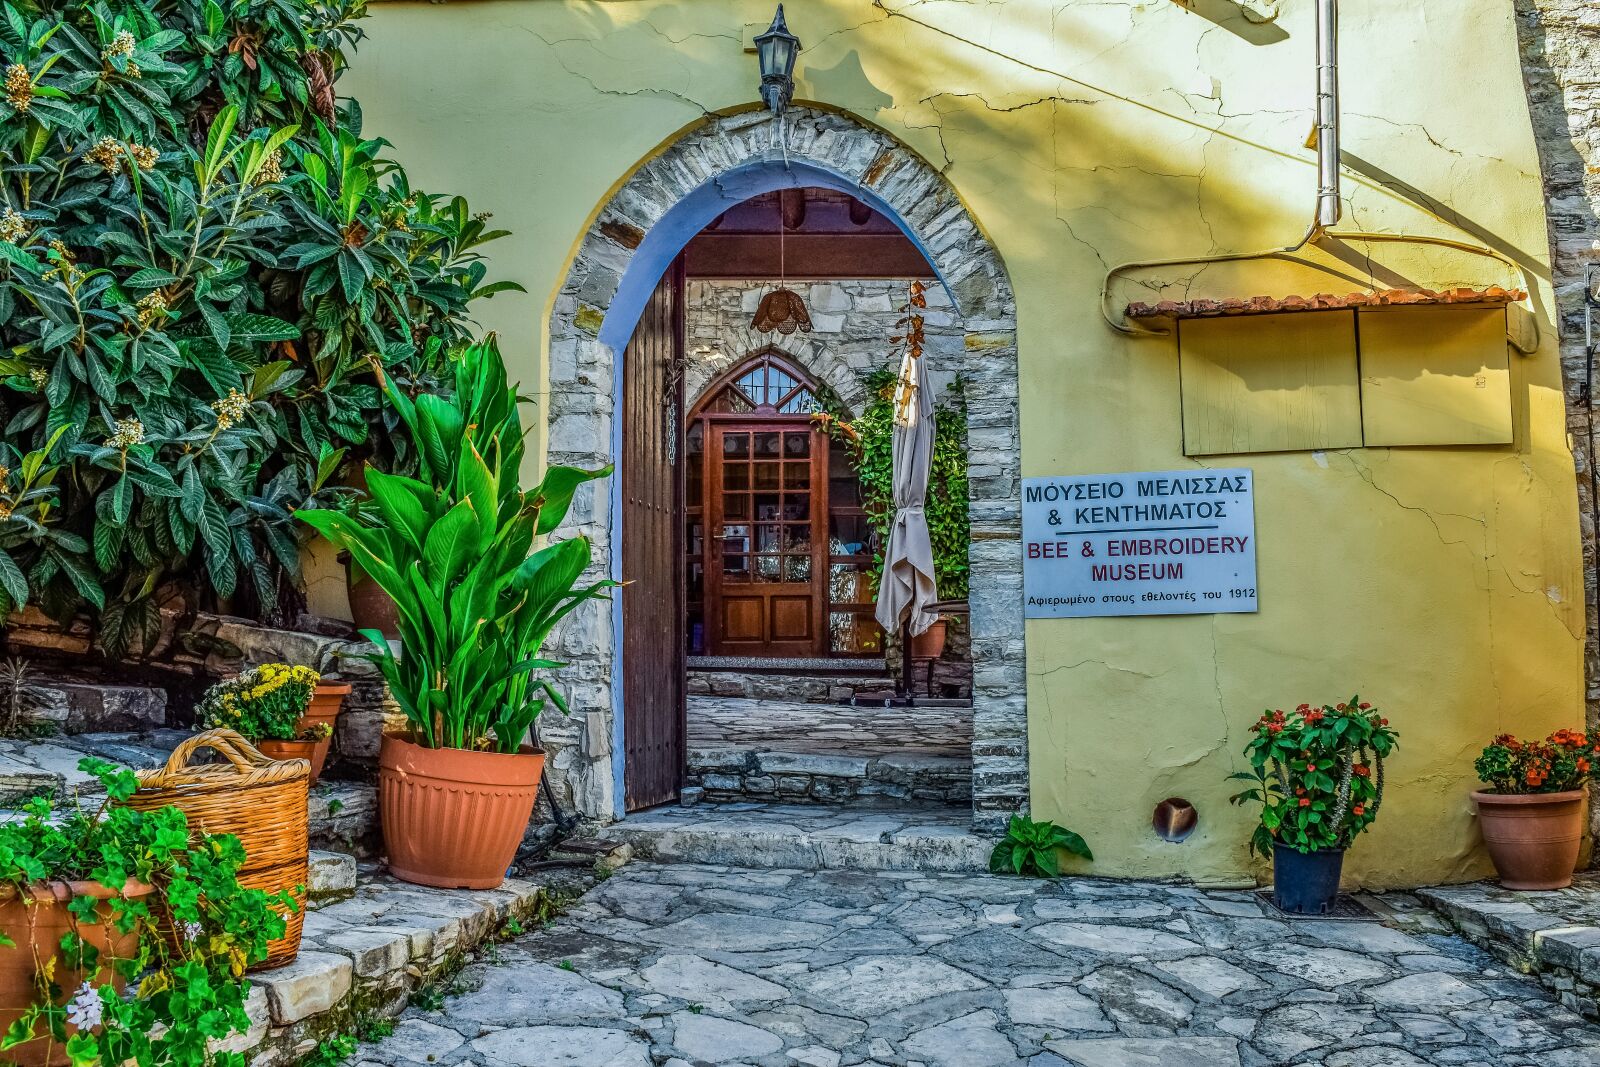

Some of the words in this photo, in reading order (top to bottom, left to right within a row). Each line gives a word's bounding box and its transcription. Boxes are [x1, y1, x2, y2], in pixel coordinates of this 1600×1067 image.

[1026, 482, 1124, 502] ΜΟΥΣΕΙΟ
[1137, 476, 1247, 497] ΜΕΛΙΣΣΑΣ
[1048, 510, 1062, 525] &
[1076, 501, 1226, 524] ΚΕΝΤΗΜΑΤΟΣ
[1028, 542, 1068, 559] BEE
[1082, 541, 1095, 557] &
[1108, 536, 1248, 556] EMBROIDERY
[1092, 563, 1183, 581] MUSEUM
[1028, 593, 1095, 606] Αφιερωμένο
[1103, 592, 1134, 603] στους
[1142, 591, 1196, 601] εθελοντές
[1203, 591, 1222, 599] του
[1229, 589, 1255, 598] 1912
